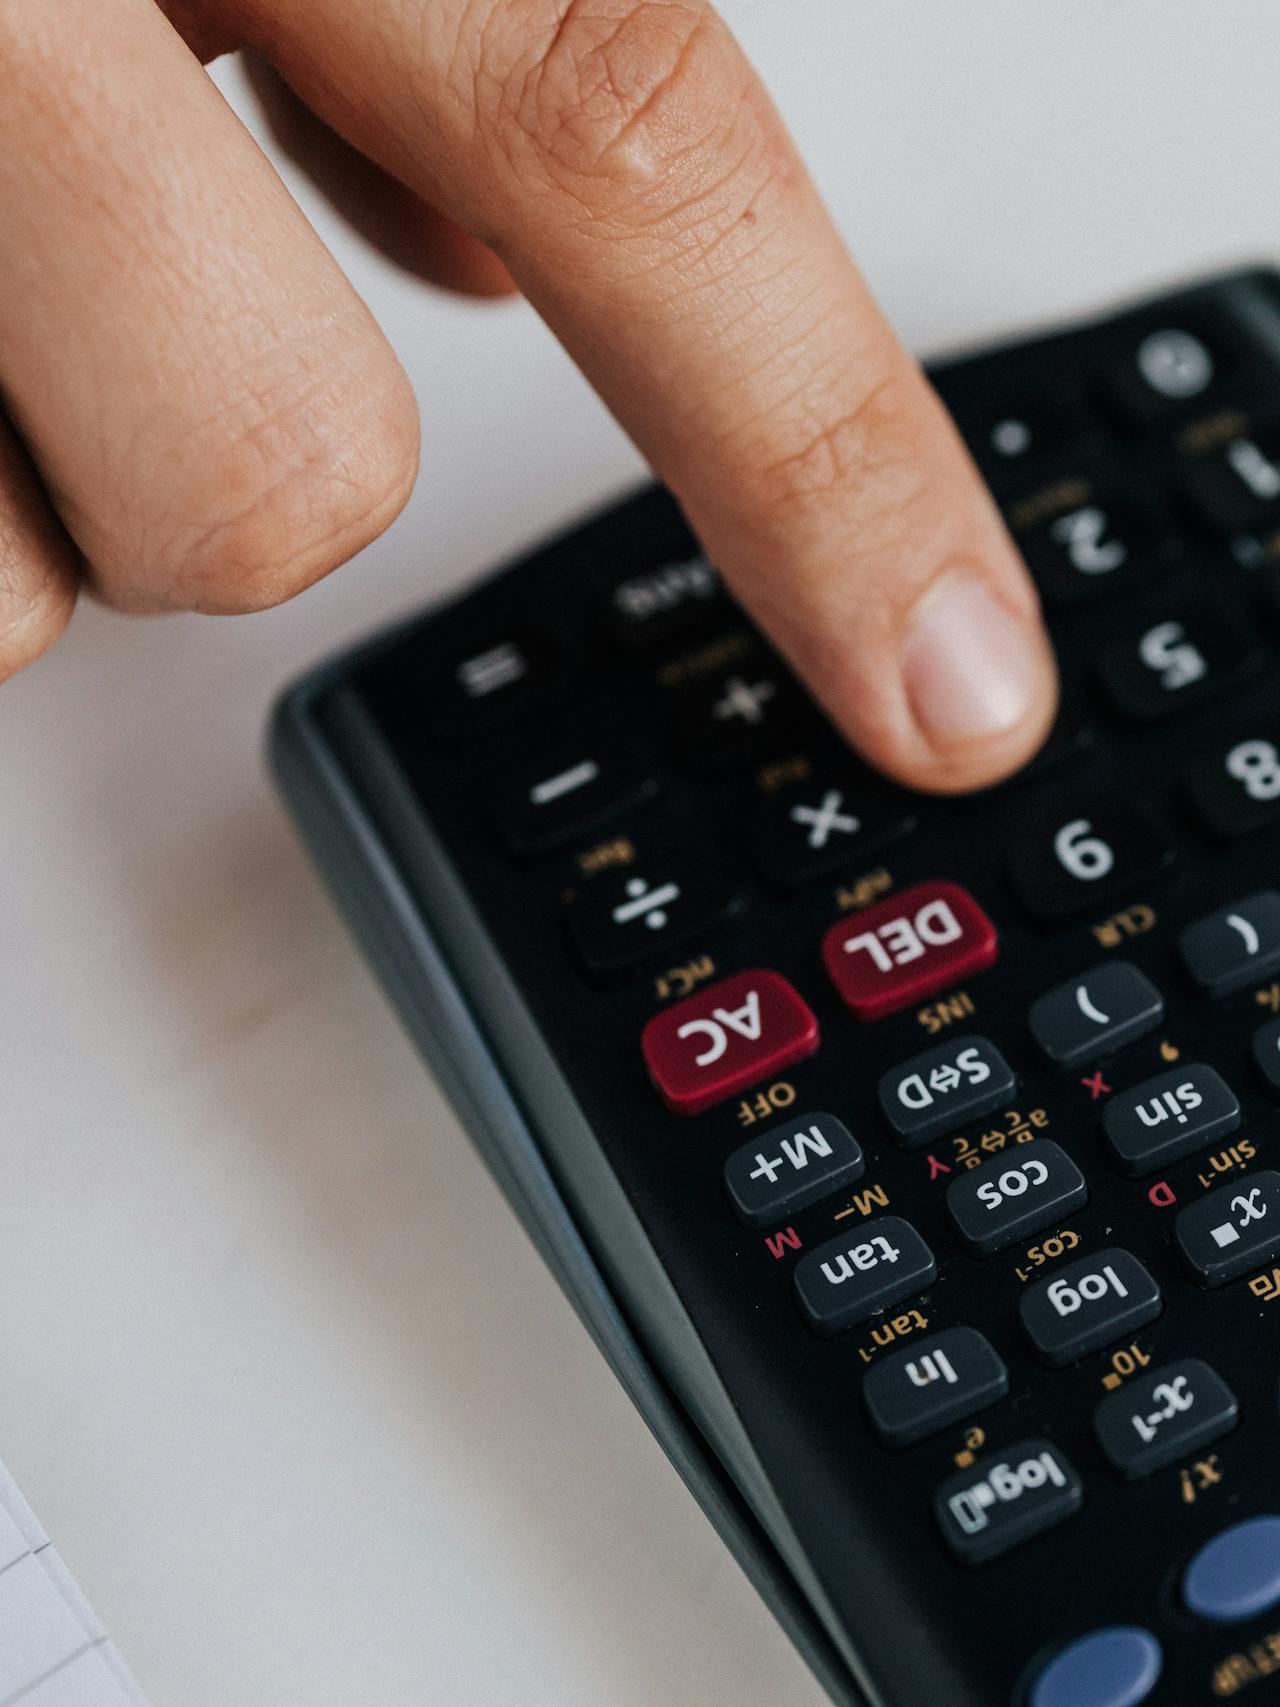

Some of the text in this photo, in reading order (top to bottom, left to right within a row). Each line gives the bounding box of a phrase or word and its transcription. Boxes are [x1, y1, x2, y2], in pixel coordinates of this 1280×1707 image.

[1056, 508, 1124, 574] 2
[1139, 621, 1207, 690] 5
[1054, 819, 1114, 881] 9
[843, 897, 964, 972] DEL
[1093, 905, 1157, 948] CLR
[677, 991, 763, 1067] AC
[918, 993, 975, 1033] INS
[737, 1082, 797, 1127] OFF
[1082, 1071, 1111, 1099] X
[1135, 1083, 1202, 1126] sin
[750, 1126, 833, 1182] M+
[927, 1155, 952, 1181] Y
[976, 1159, 1049, 1210] cos
[1148, 1181, 1178, 1208] D
[765, 1227, 802, 1259] M
[820, 1237, 900, 1284] tan
[1048, 1266, 1128, 1316] log
[904, 1349, 958, 1387] ln
[1180, 1455, 1221, 1503] x!
